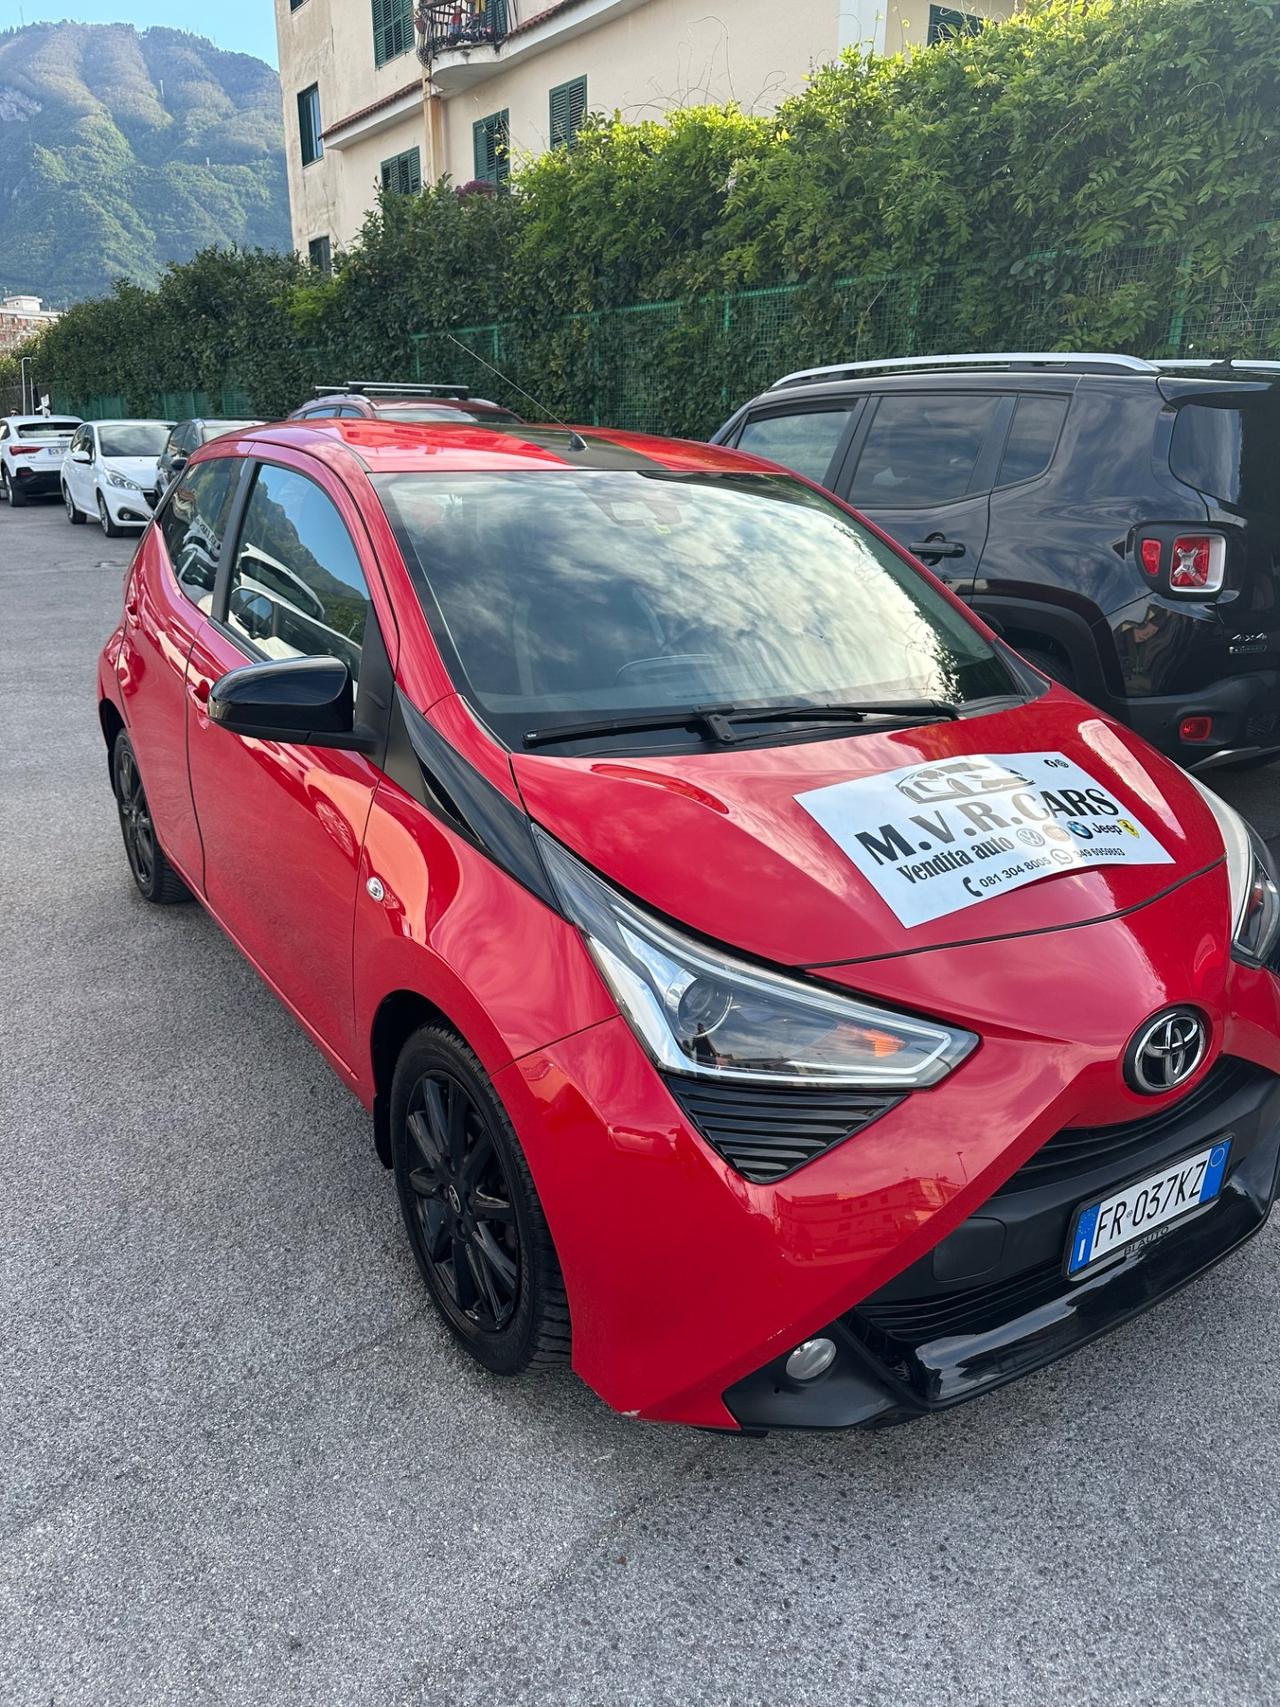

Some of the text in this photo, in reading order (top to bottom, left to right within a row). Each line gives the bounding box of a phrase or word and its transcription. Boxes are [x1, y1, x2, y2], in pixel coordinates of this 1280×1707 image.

[1092, 822, 1123, 836] Jeep
[896, 836, 1015, 885] Vendita auto
[979, 873, 1003, 888] 081
[1002, 864, 1025, 879] 304
[1027, 856, 1052, 871] 8005
